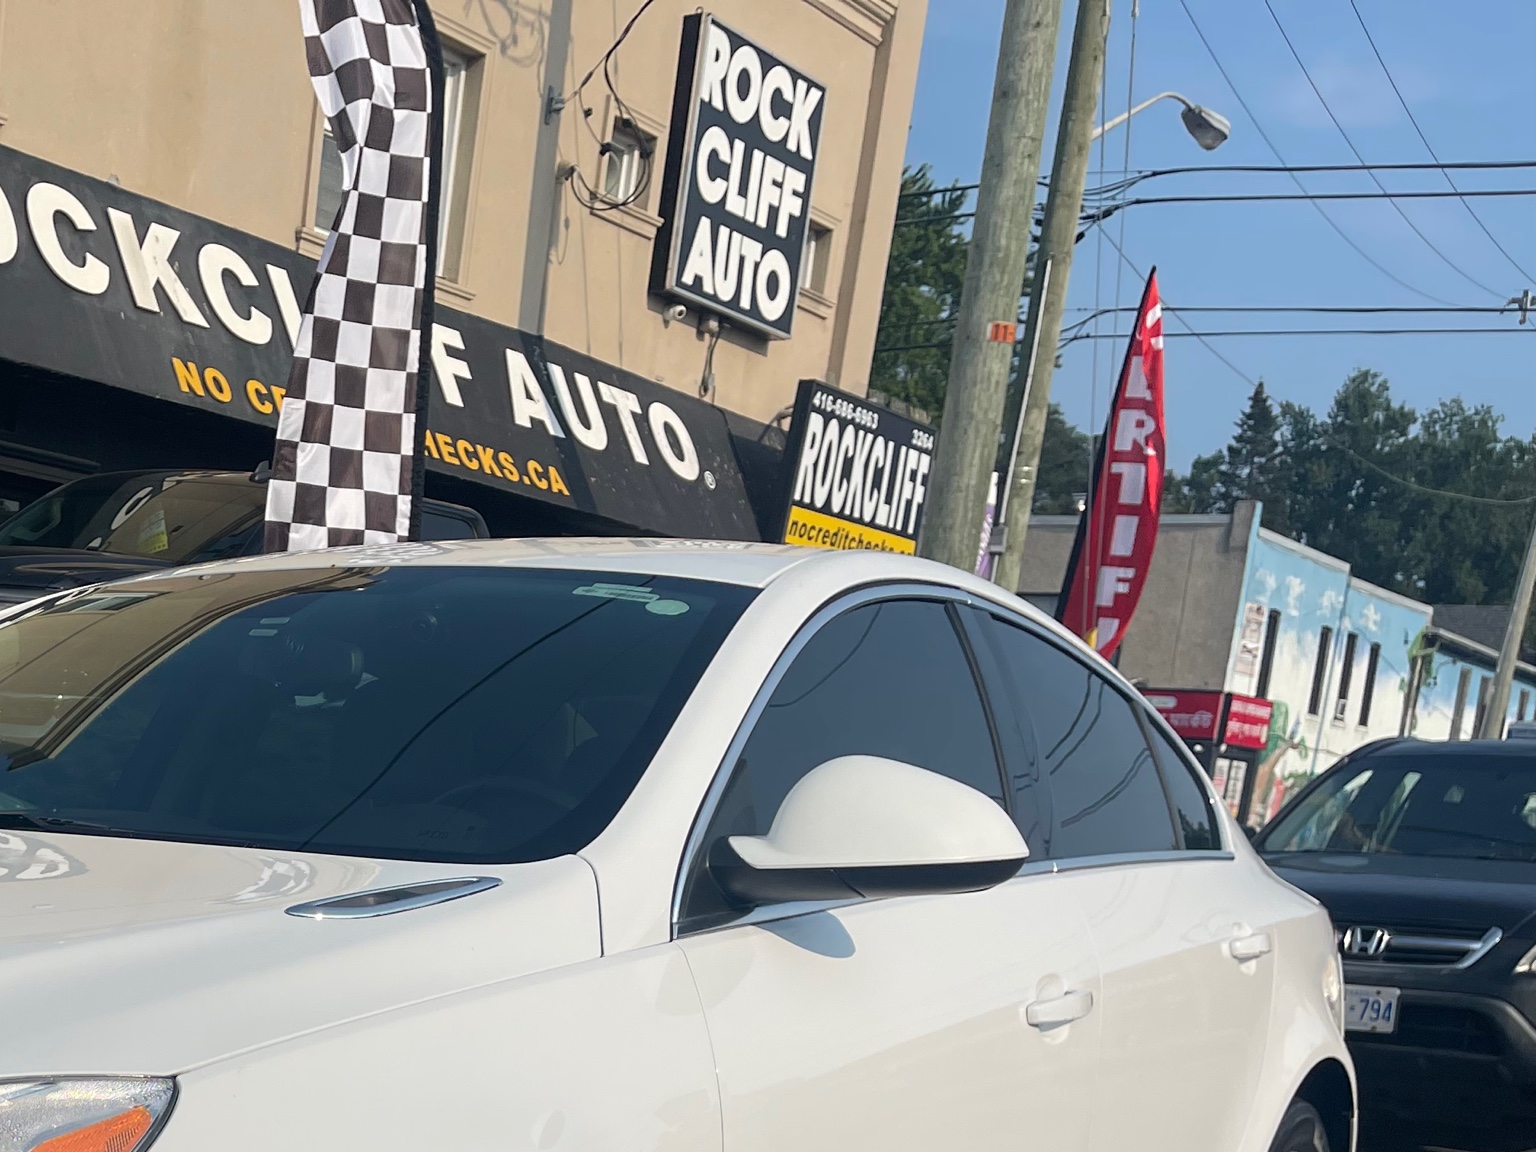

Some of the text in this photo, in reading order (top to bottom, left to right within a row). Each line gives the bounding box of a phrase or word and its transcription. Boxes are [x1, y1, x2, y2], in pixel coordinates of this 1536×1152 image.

[700, 23, 823, 160] ROCK
[696, 125, 807, 239] CLIFF
[680, 215, 792, 322] AUTO
[172, 357, 232, 403] NO
[505, 348, 700, 481] AUTO
[793, 412, 931, 535] ROCKCLIFF
[1359, 998, 1393, 1022] 794
